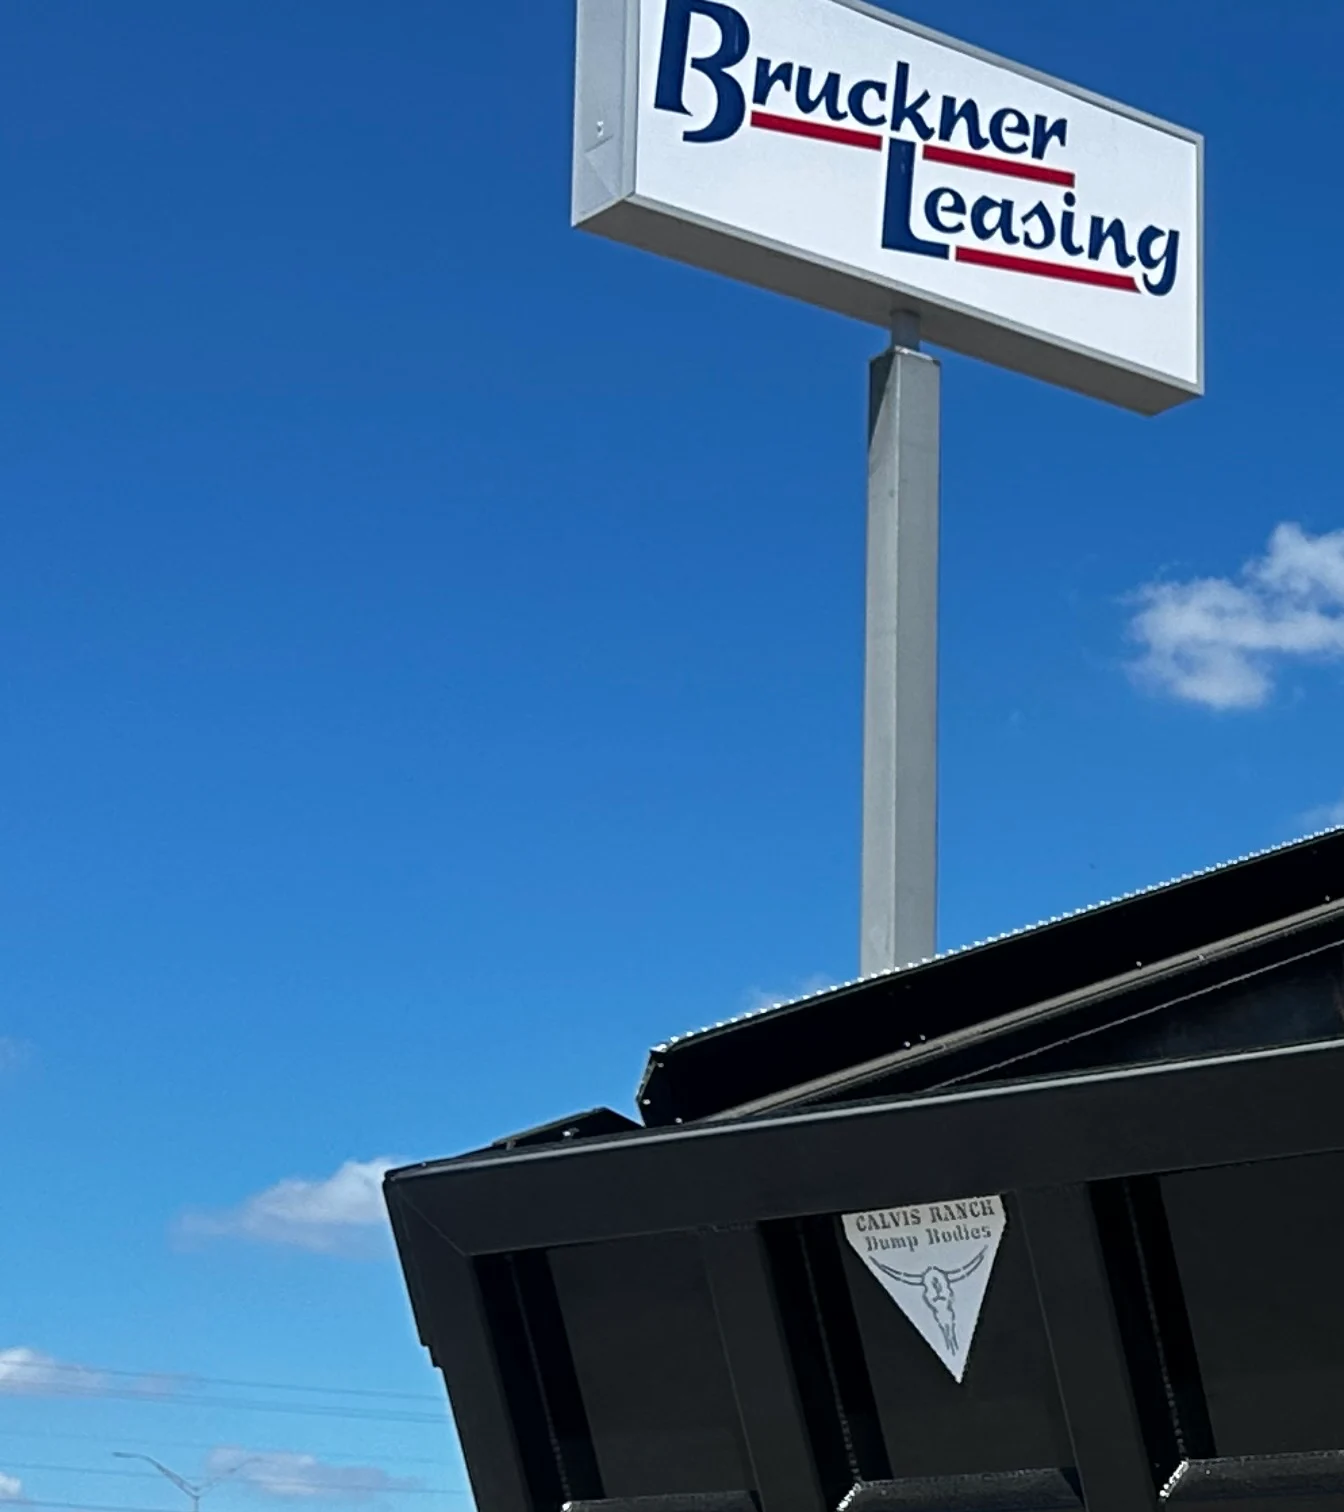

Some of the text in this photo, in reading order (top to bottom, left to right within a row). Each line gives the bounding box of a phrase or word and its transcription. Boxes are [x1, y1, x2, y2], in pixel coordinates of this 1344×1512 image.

[654, 0, 1068, 160] Bruckner
[881, 138, 1180, 297] Leasing
[856, 1199, 995, 1232] CALVIS RANCH
[865, 1234, 918, 1252] Dump
